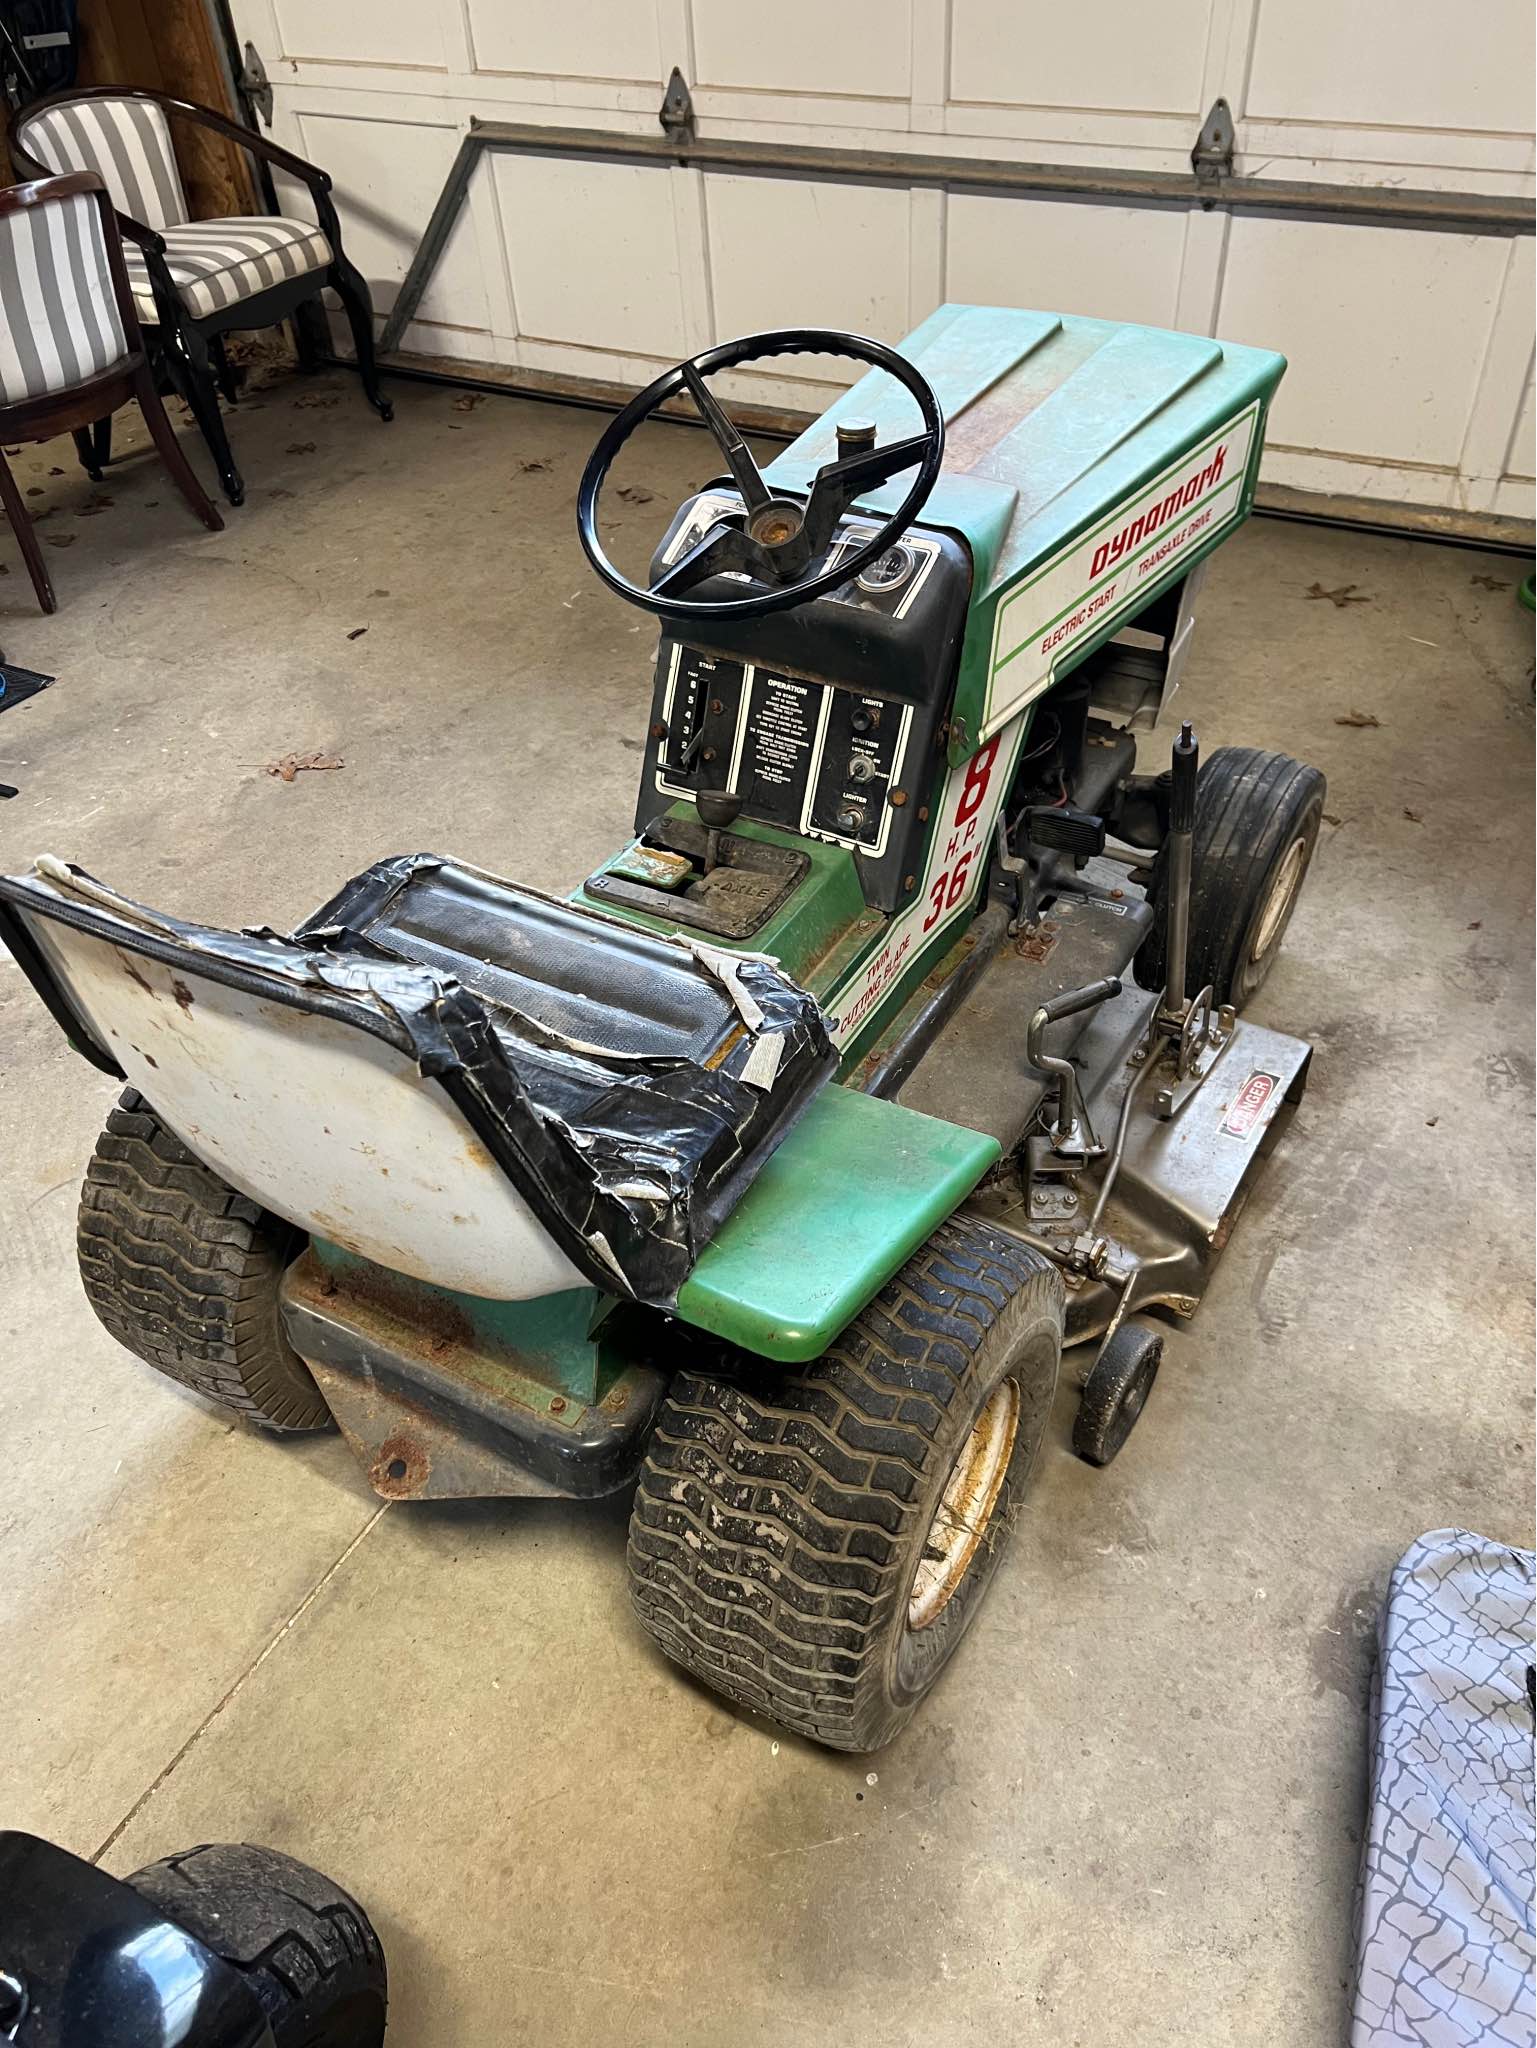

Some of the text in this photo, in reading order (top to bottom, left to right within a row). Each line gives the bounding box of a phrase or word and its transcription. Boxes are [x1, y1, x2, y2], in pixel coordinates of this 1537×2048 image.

[1041, 508, 1213, 655] ELECTRIC START TRANSAXLE DRIVE
[698, 661, 717, 671] START
[690, 680, 697, 689] 6
[767, 678, 808, 696] OPERATION
[687, 695, 695, 704] 5
[861, 697, 884, 708] LIGHTS
[684, 710, 692, 720] 4
[682, 725, 690, 735] 3
[681, 741, 688, 750] 2
[851, 736, 880, 749] IGNITION
[954, 735, 1001, 828] 8
[842, 792, 868, 804] LIGHTER
[866, 944, 891, 983] TWIN
[840, 974, 882, 1034] CUTTING
[883, 933, 911, 979] BLADE
